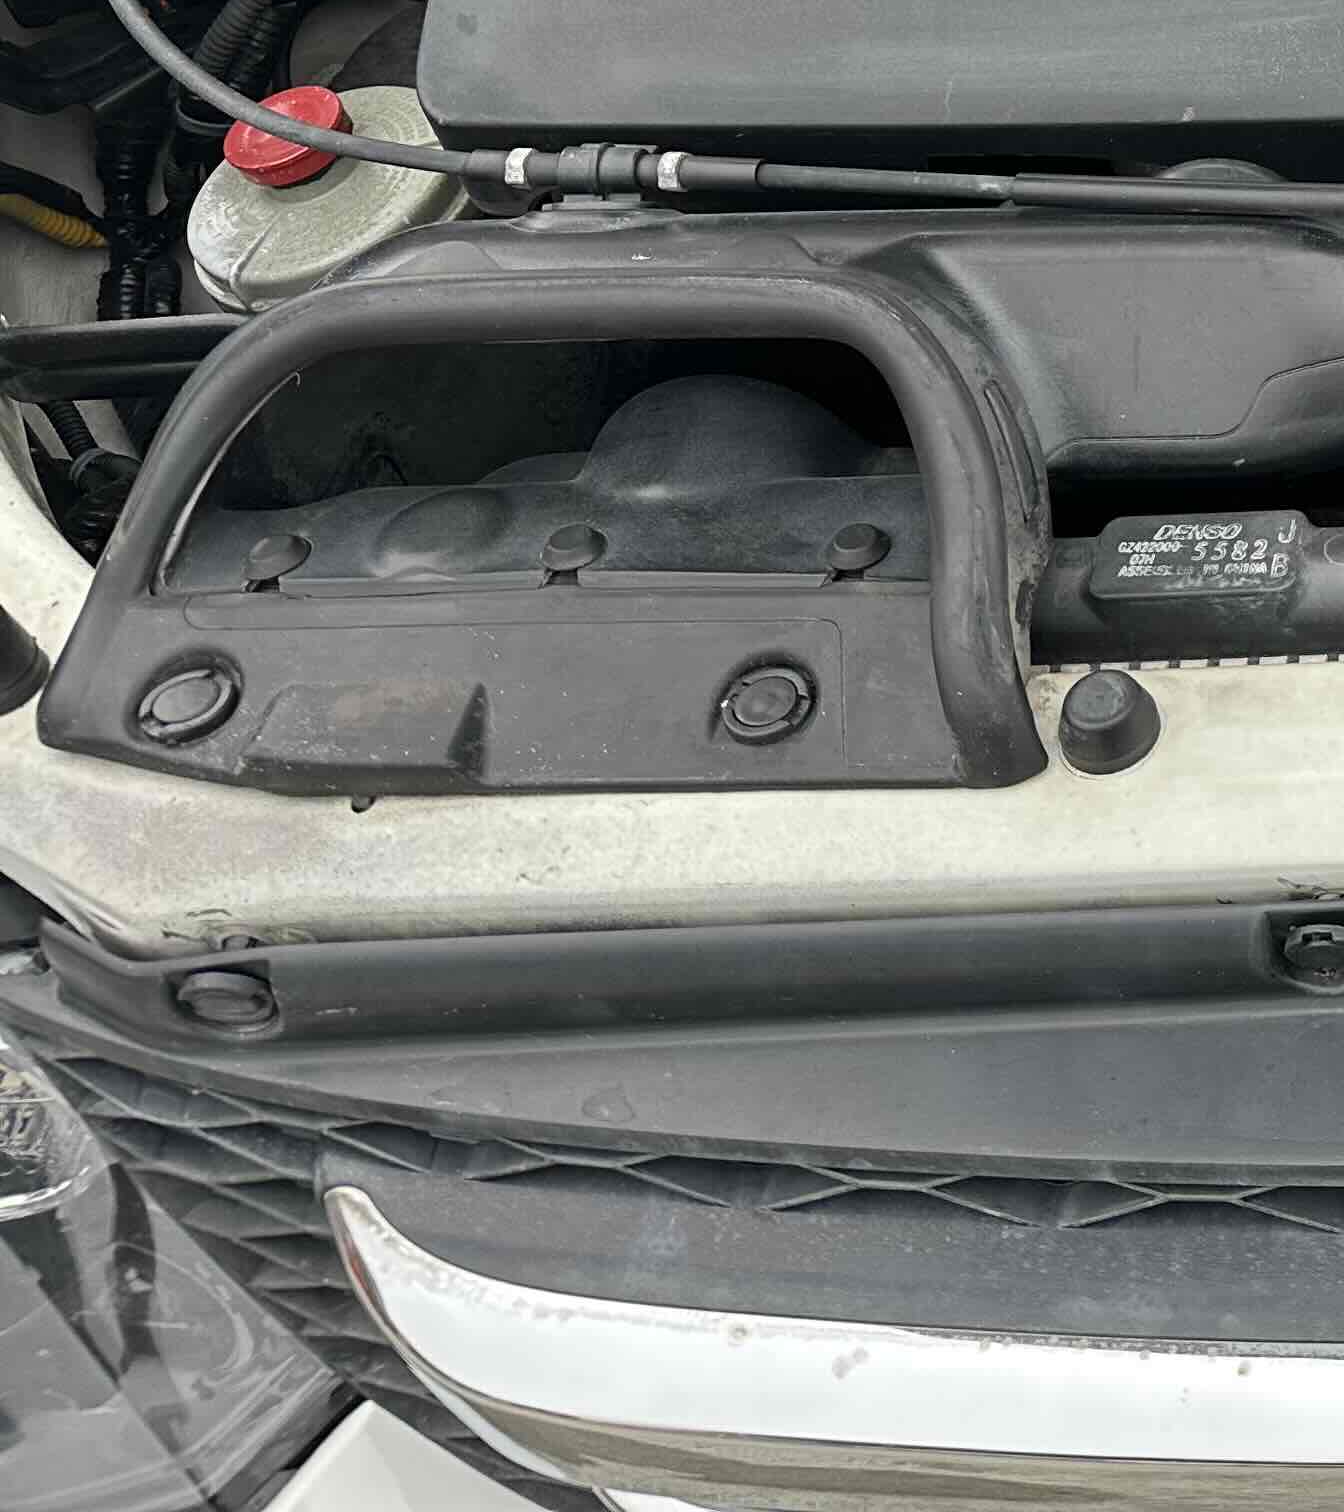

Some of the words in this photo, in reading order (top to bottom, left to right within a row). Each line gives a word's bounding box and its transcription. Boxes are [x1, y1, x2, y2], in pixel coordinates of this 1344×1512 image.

[1152, 522, 1244, 541] DENSO
[1277, 519, 1297, 544] J
[1190, 538, 1269, 562] 5582
